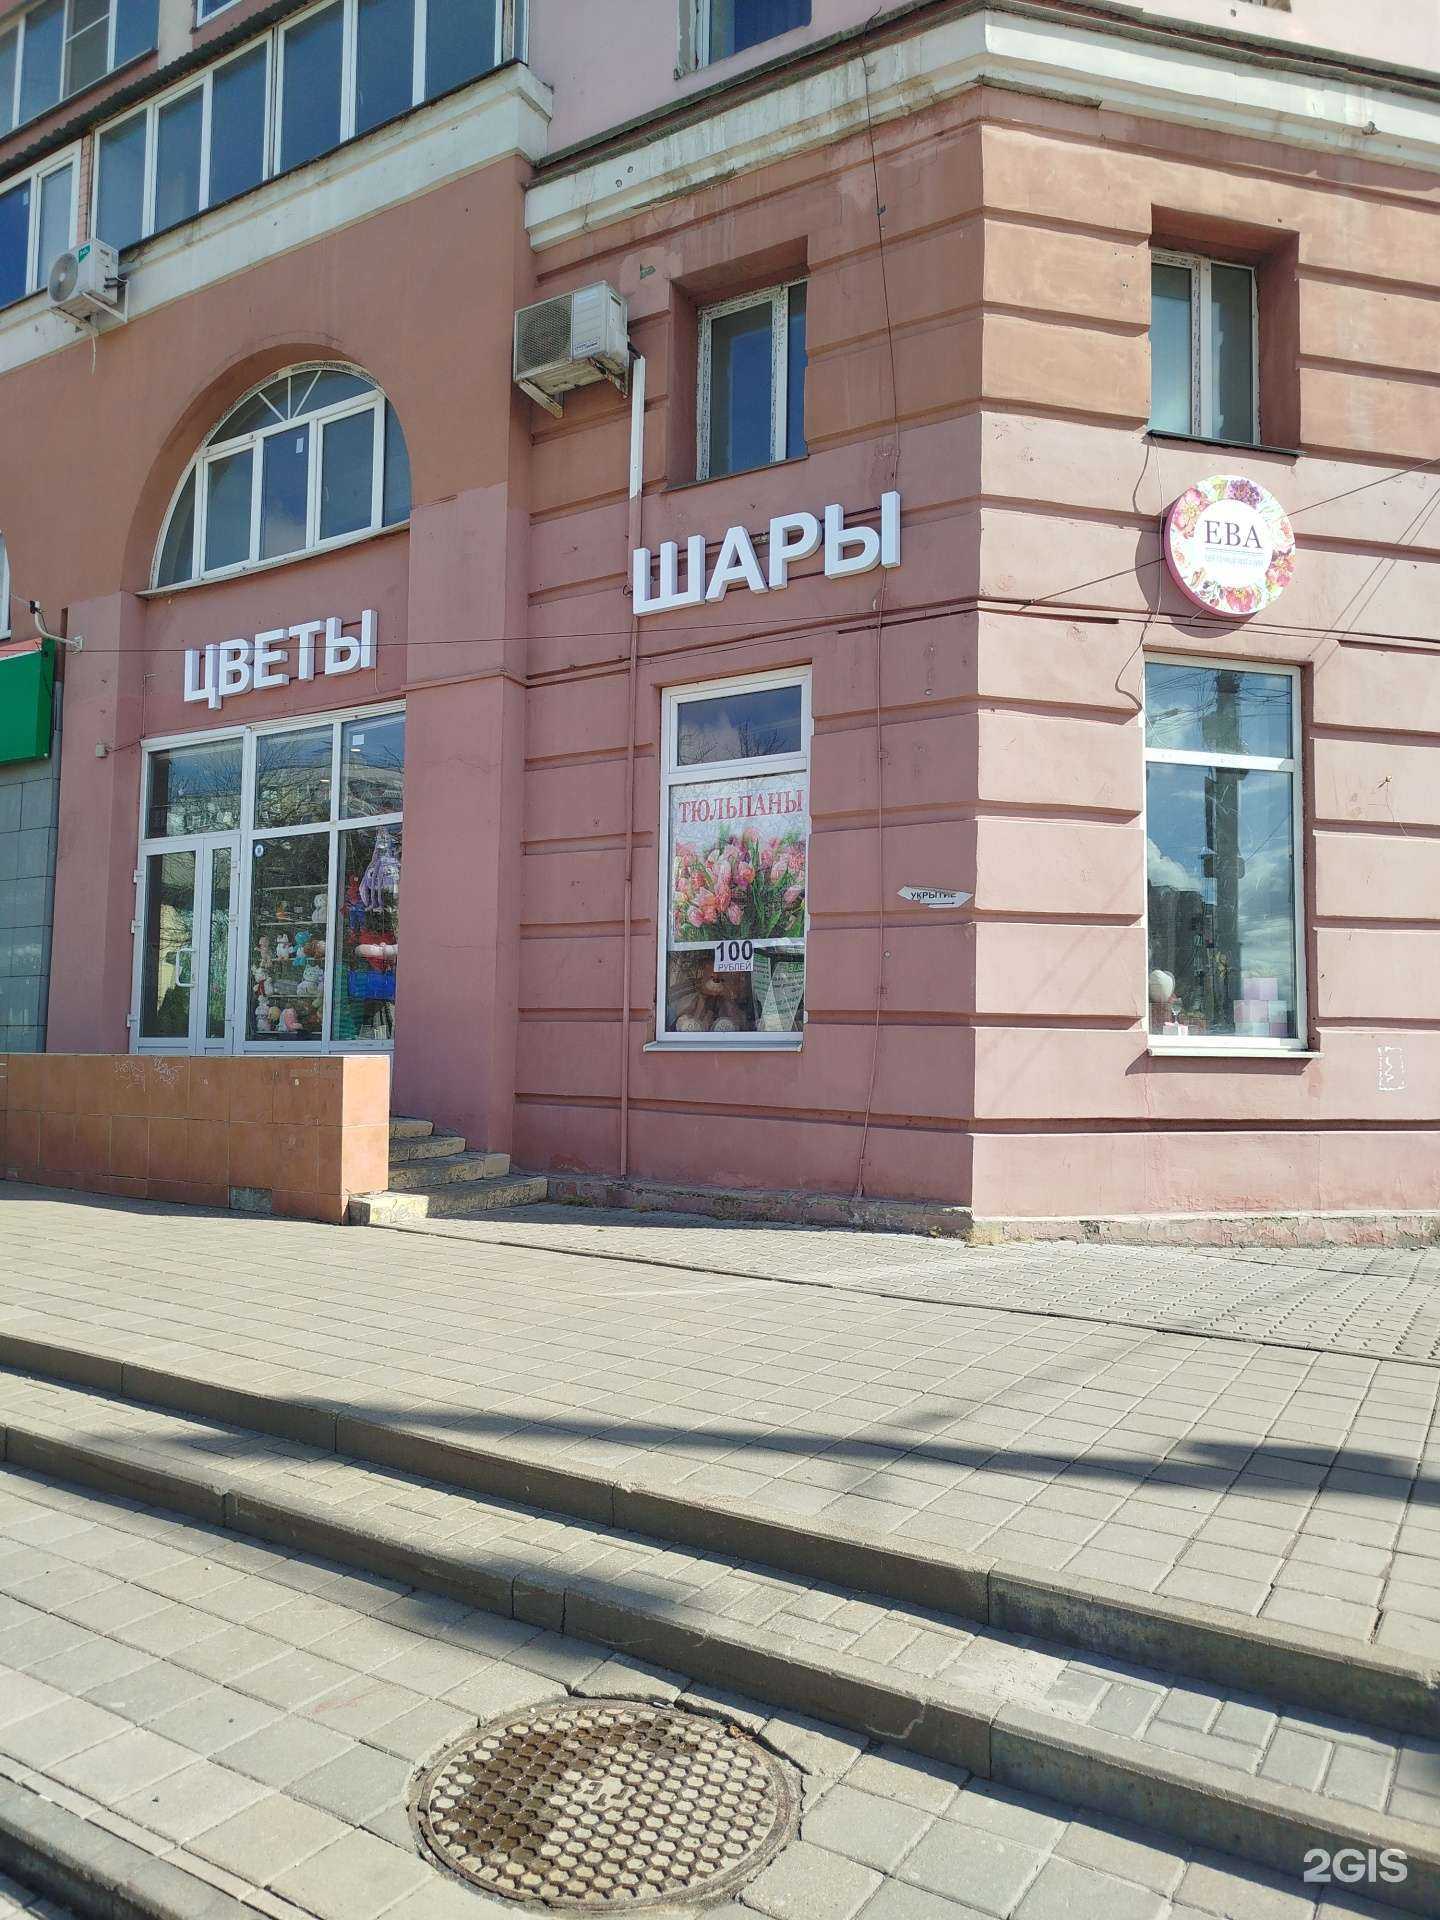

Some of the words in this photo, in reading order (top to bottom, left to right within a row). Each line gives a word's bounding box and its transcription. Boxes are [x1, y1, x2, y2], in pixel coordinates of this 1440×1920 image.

[1204, 520, 1264, 549] ЕВА
[633, 490, 901, 615] ШАРЫ
[184, 609, 378, 710] ЦВЕТЫ
[679, 790, 804, 823] ТЮЛЬПАНЫ
[716, 940, 753, 961] 100
[719, 961, 752, 971] РУБЛЕЙ
